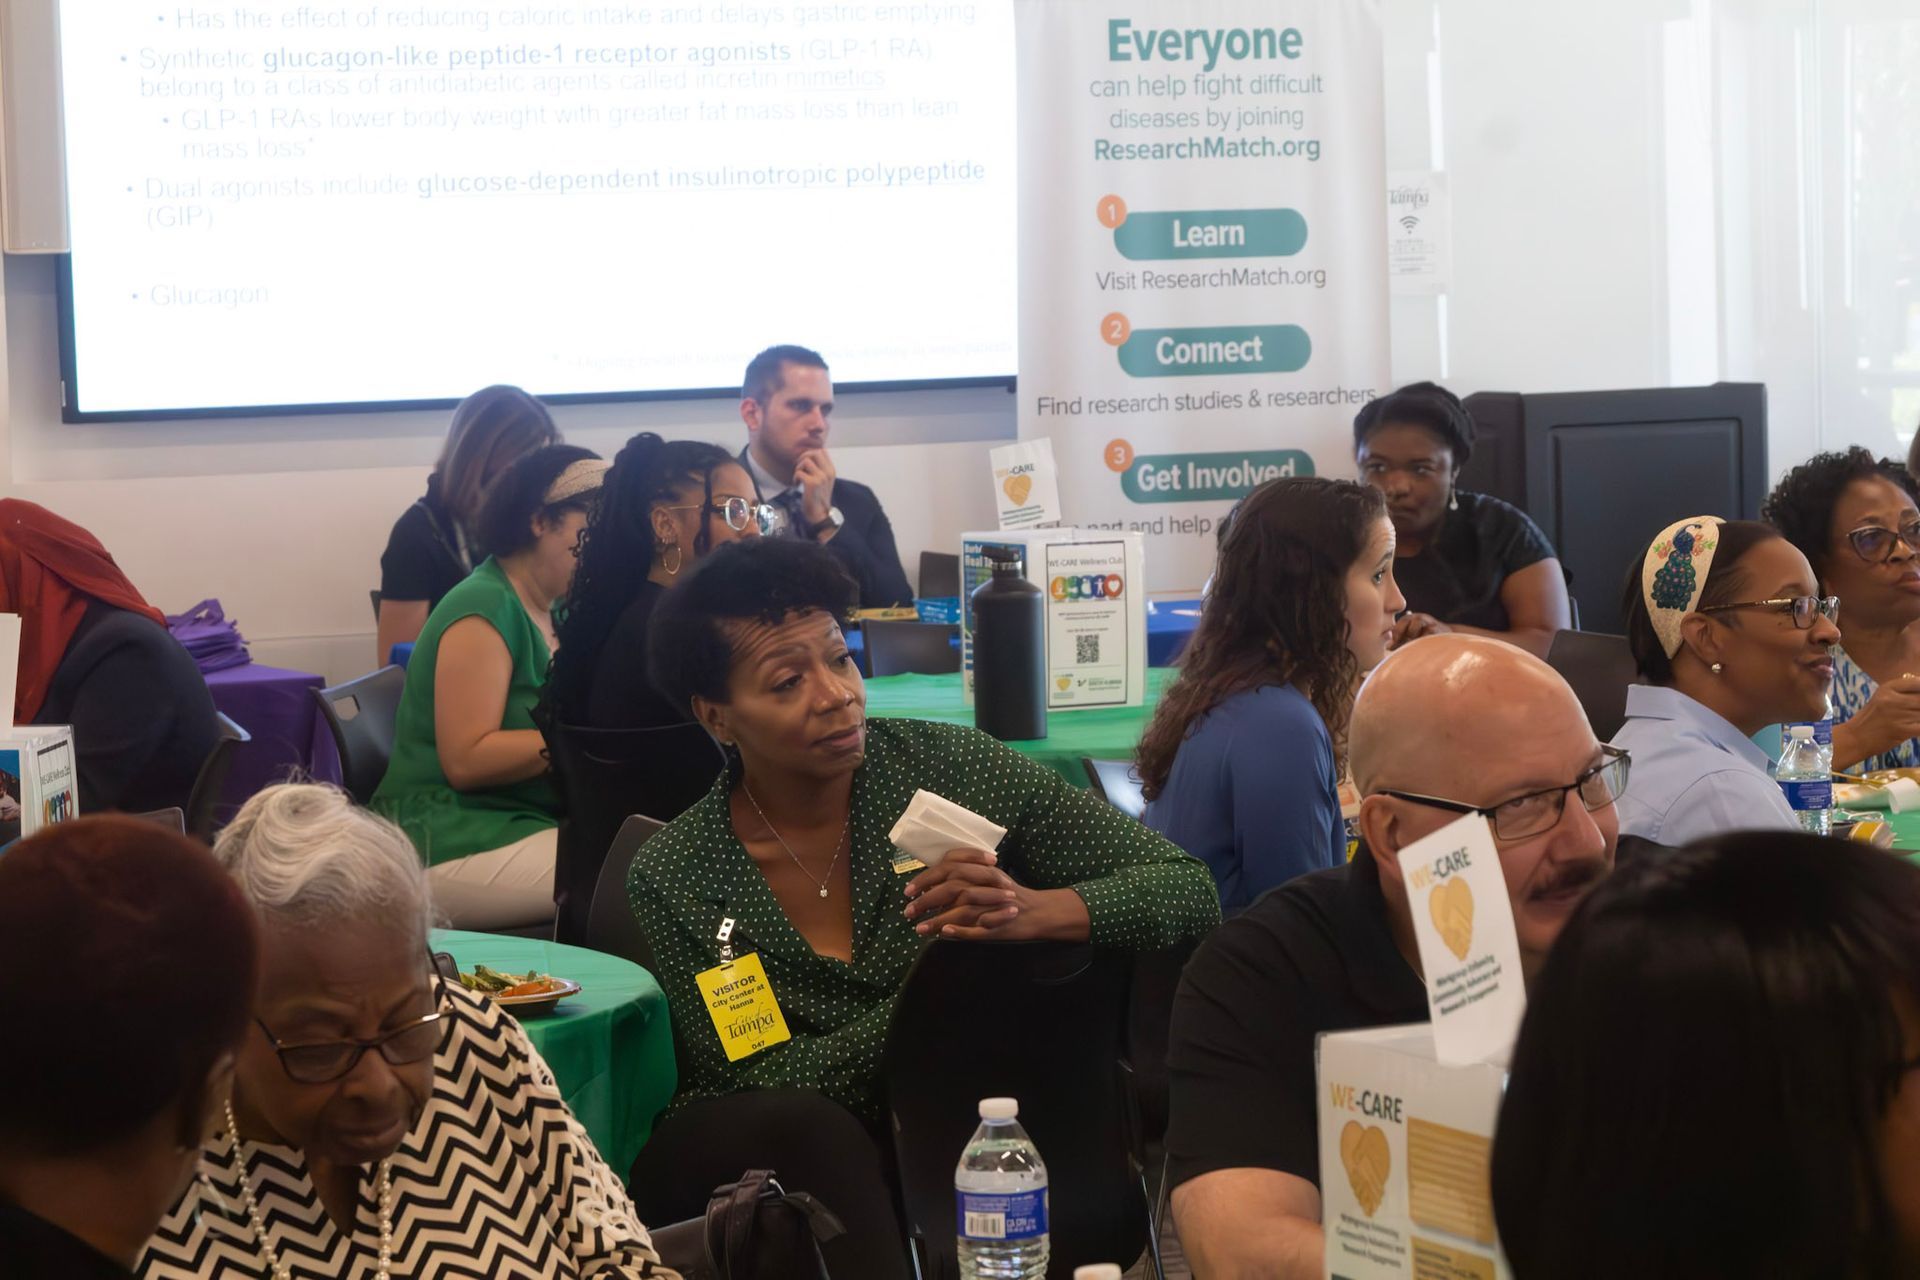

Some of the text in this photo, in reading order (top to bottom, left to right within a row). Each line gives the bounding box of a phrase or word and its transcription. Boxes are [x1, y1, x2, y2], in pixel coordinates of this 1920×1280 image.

[177, 2, 977, 31] Has the effect of reducing caloric intake and delays gastric emptying
[139, 37, 934, 73] Synthetic glucagon-like peptide-1 receptor agonists (GLP-1 RA)
[1108, 19, 1303, 72] Everyone
[140, 67, 885, 101] belong to a class of antidiabetic agents called incretin mimetics
[1090, 74, 1324, 100] can help fight difficult
[182, 97, 959, 133] GLP-1 RAs lower body weight with greater fat mass loss than lean
[1110, 106, 1304, 131] diseases by joining
[183, 140, 248, 159] mass
[1095, 136, 1321, 161] ResearchMatch.org
[145, 160, 985, 202] Dual agonists include glucose-dependent insulinotropic polypeptide
[146, 205, 214, 232] (GIP)
[1107, 204, 1117, 221] 1
[1173, 219, 1246, 247] Learn
[1096, 267, 1327, 290] Visit ResearchMatch.org
[150, 284, 269, 309] Glucagon
[1111, 320, 1122, 338] 2
[1156, 335, 1264, 365] Connect
[1038, 386, 1376, 416] Find research studies & researchers
[1114, 447, 1126, 465] 3
[1137, 458, 1295, 492] Get Involved
[1130, 517, 1163, 535] and
[1170, 515, 1212, 537] help
[1410, 847, 1472, 890] WE-CARE
[712, 999, 728, 1009] City
[730, 988, 755, 1002] Center
[713, 975, 756, 997] VISITOR
[730, 999, 754, 1012] Hanna
[724, 1012, 775, 1039] Tampa
[1330, 1082, 1403, 1124] WE-CARE
